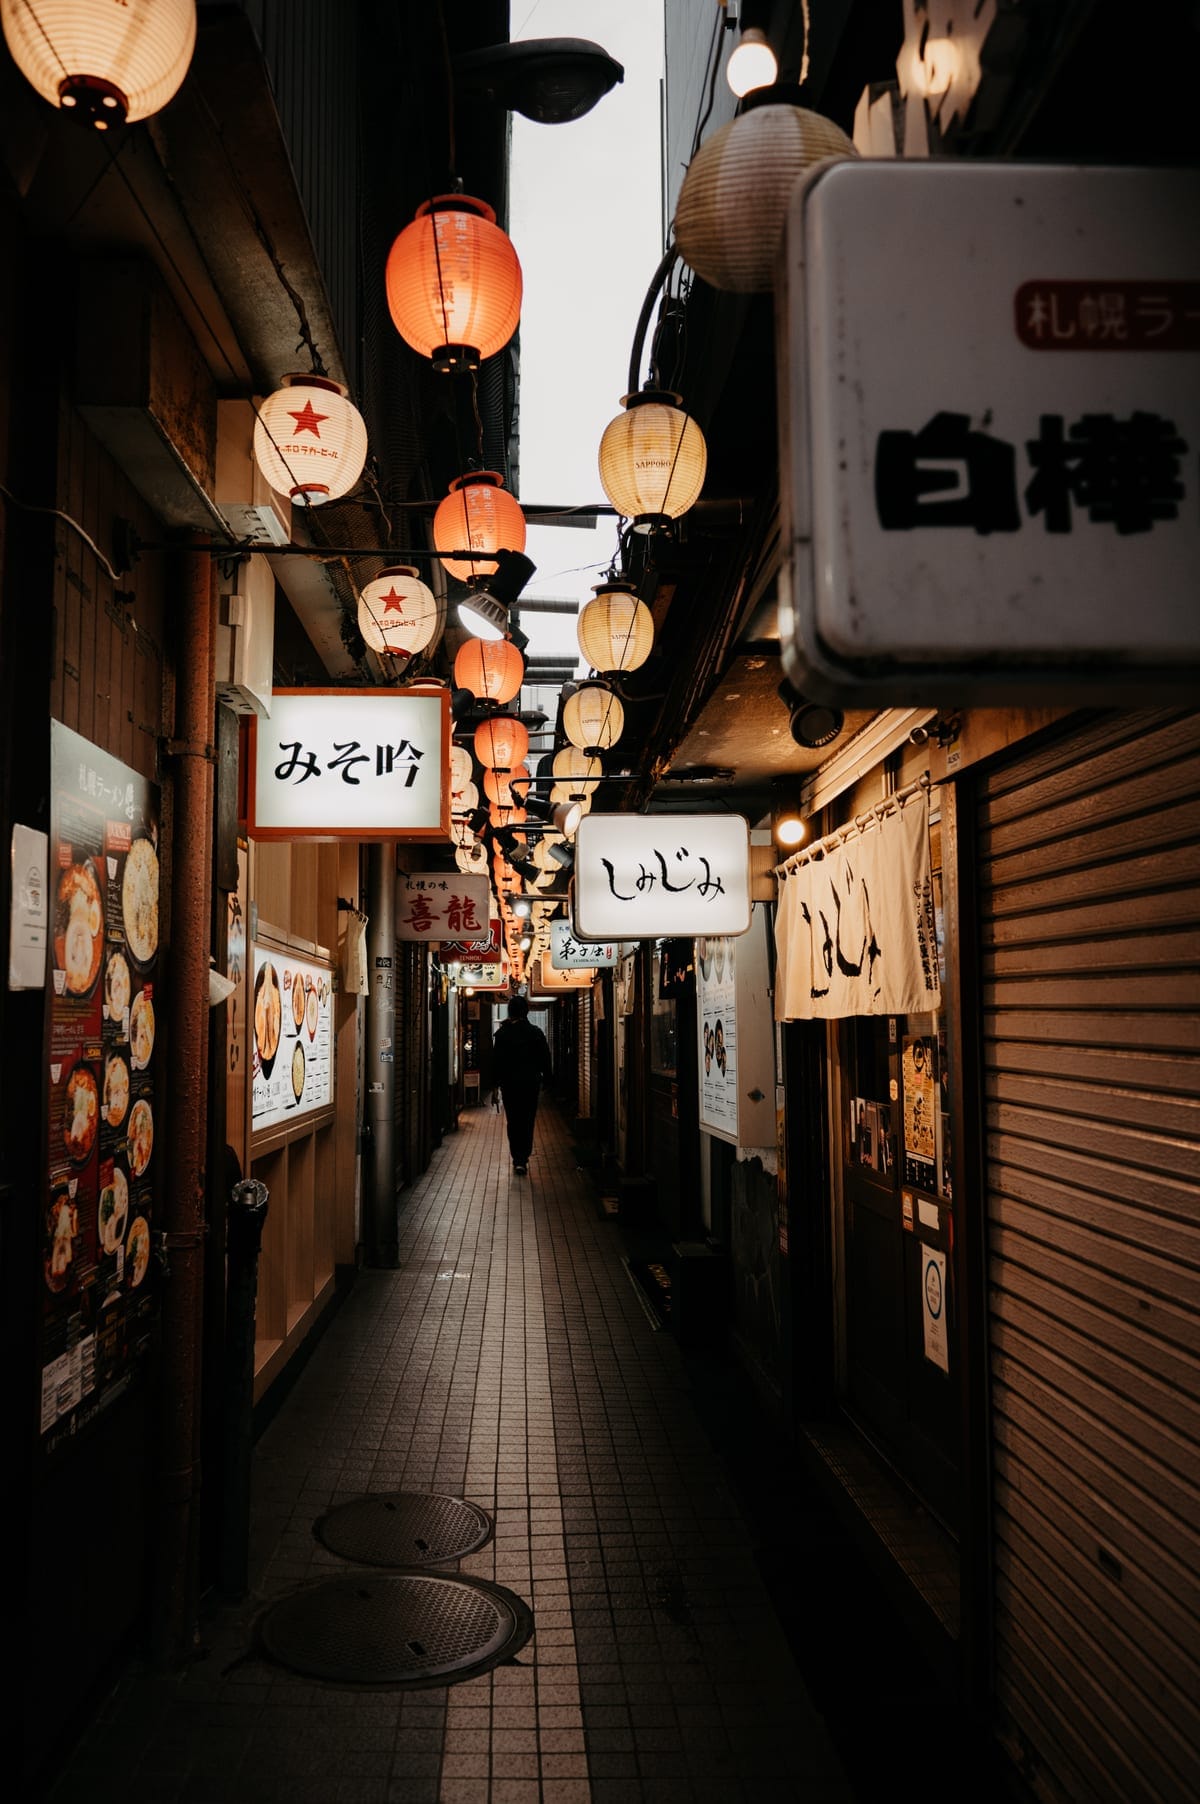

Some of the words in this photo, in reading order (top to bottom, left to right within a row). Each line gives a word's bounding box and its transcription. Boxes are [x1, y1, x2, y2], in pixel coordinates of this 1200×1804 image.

[635, 460, 671, 469] SAPPORO
[876, 411, 1189, 536] 白樺
[274, 739, 425, 788] みそ吟
[405, 880, 449, 891] 札幌の味
[600, 846, 725, 902] しみじみ
[402, 894, 482, 932] 喜龍
